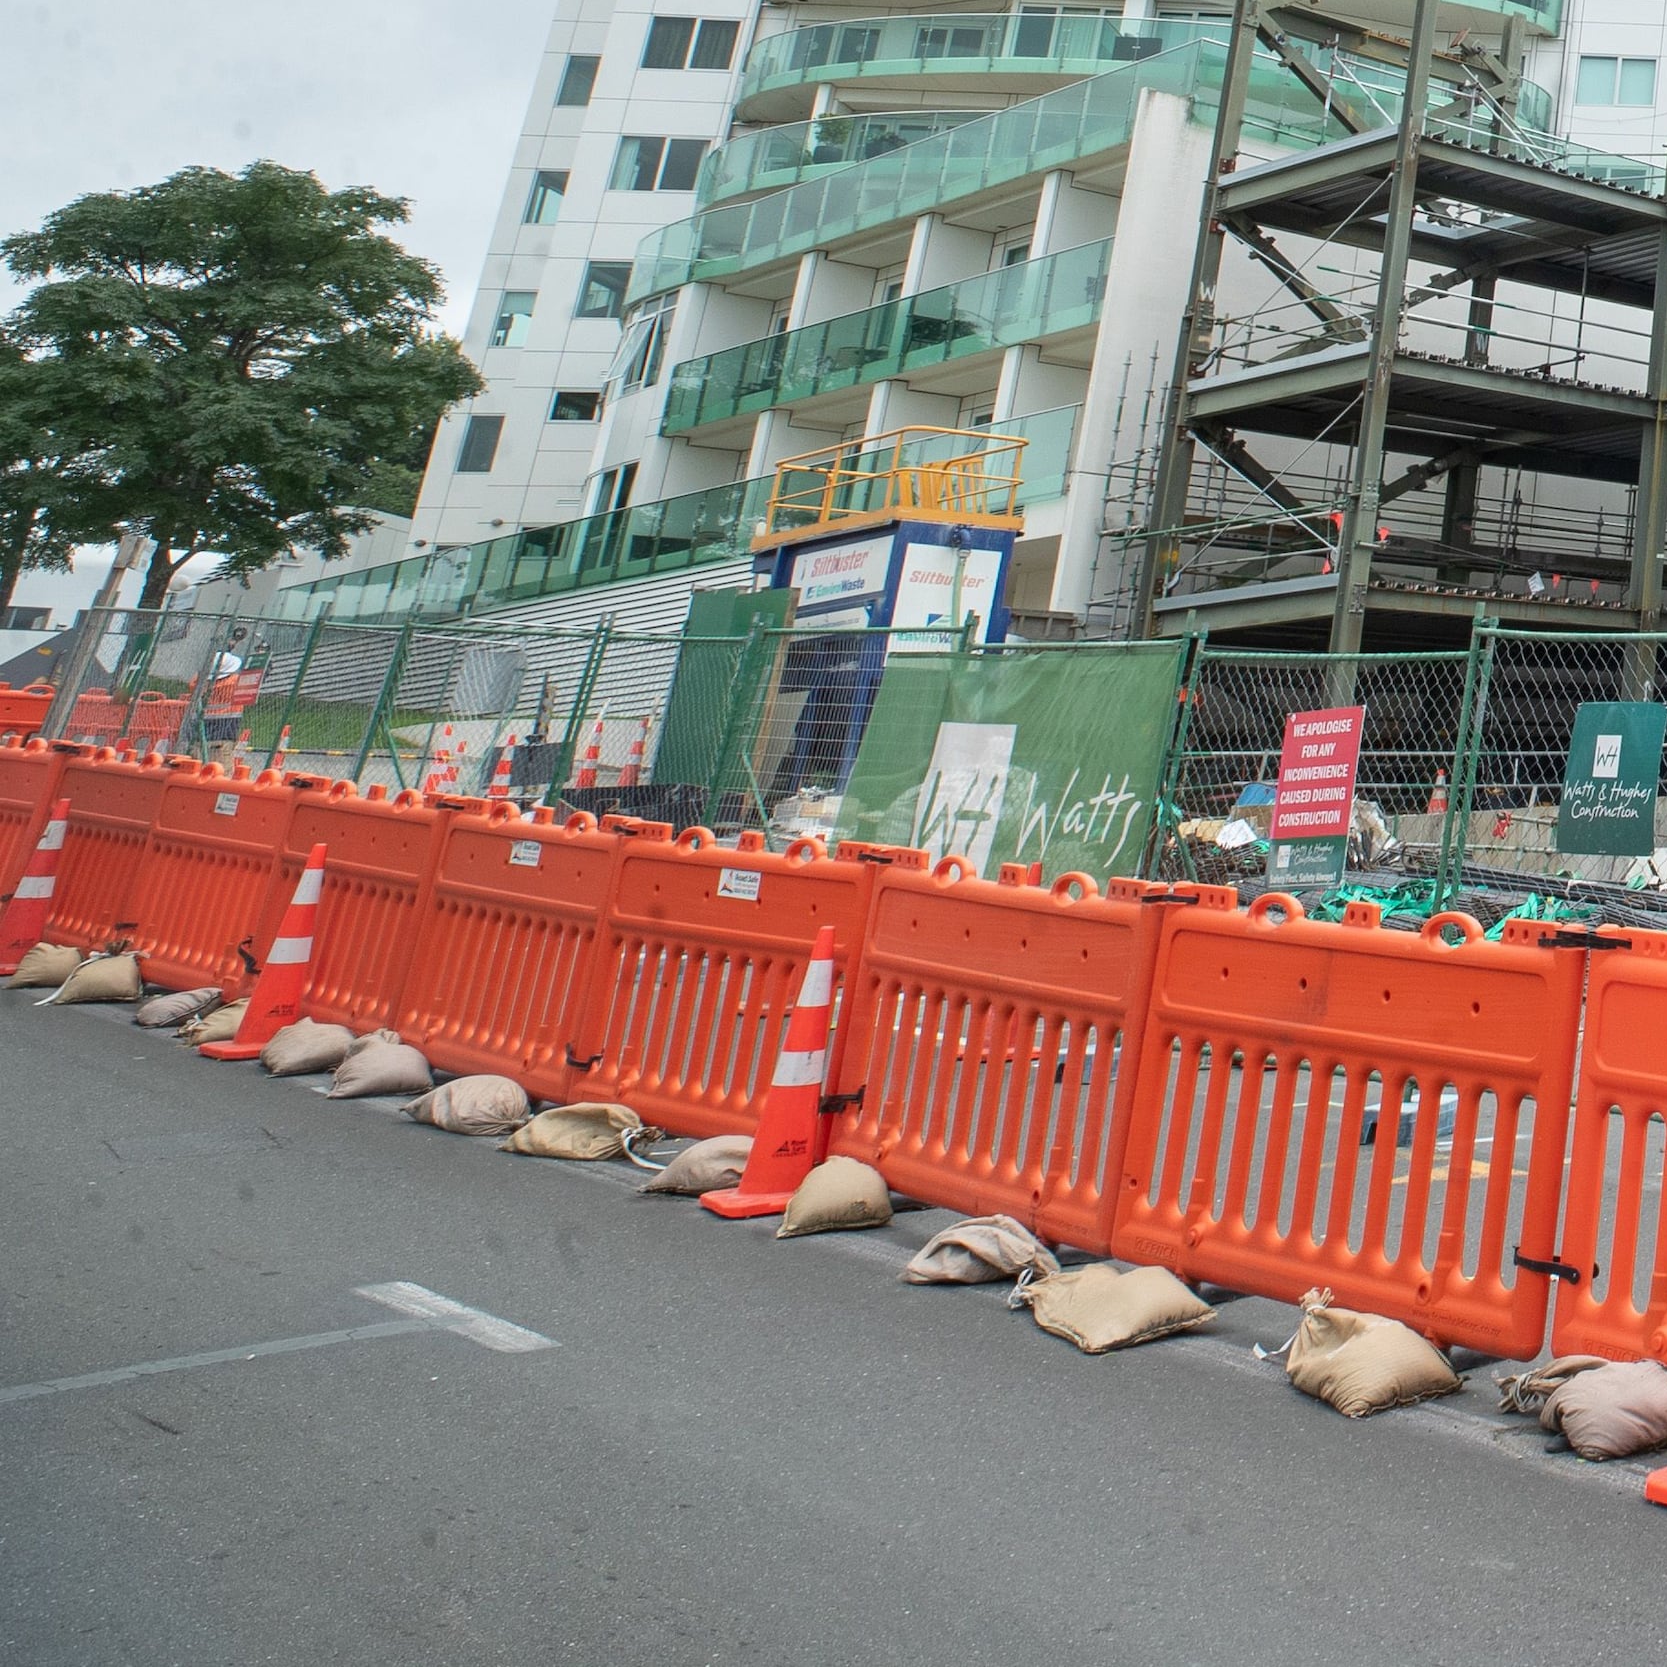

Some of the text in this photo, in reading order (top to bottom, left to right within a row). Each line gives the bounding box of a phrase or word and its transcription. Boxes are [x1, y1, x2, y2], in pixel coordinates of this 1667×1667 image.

[811, 550, 871, 578] Siltbuster
[909, 570, 984, 588] Siltbuter
[1293, 718, 1353, 738] WE APOLOGISE
[1301, 742, 1336, 758] FOR ANY
[1596, 743, 1618, 768] WH
[1283, 763, 1349, 782] INCONVENIENCE
[1279, 787, 1346, 805] CAUSED DURING
[1563, 779, 1653, 807] Watts & Hughes
[1015, 767, 1142, 869] Watts
[1278, 810, 1341, 827] CONSTRUCTION
[1571, 799, 1640, 823] Construction
